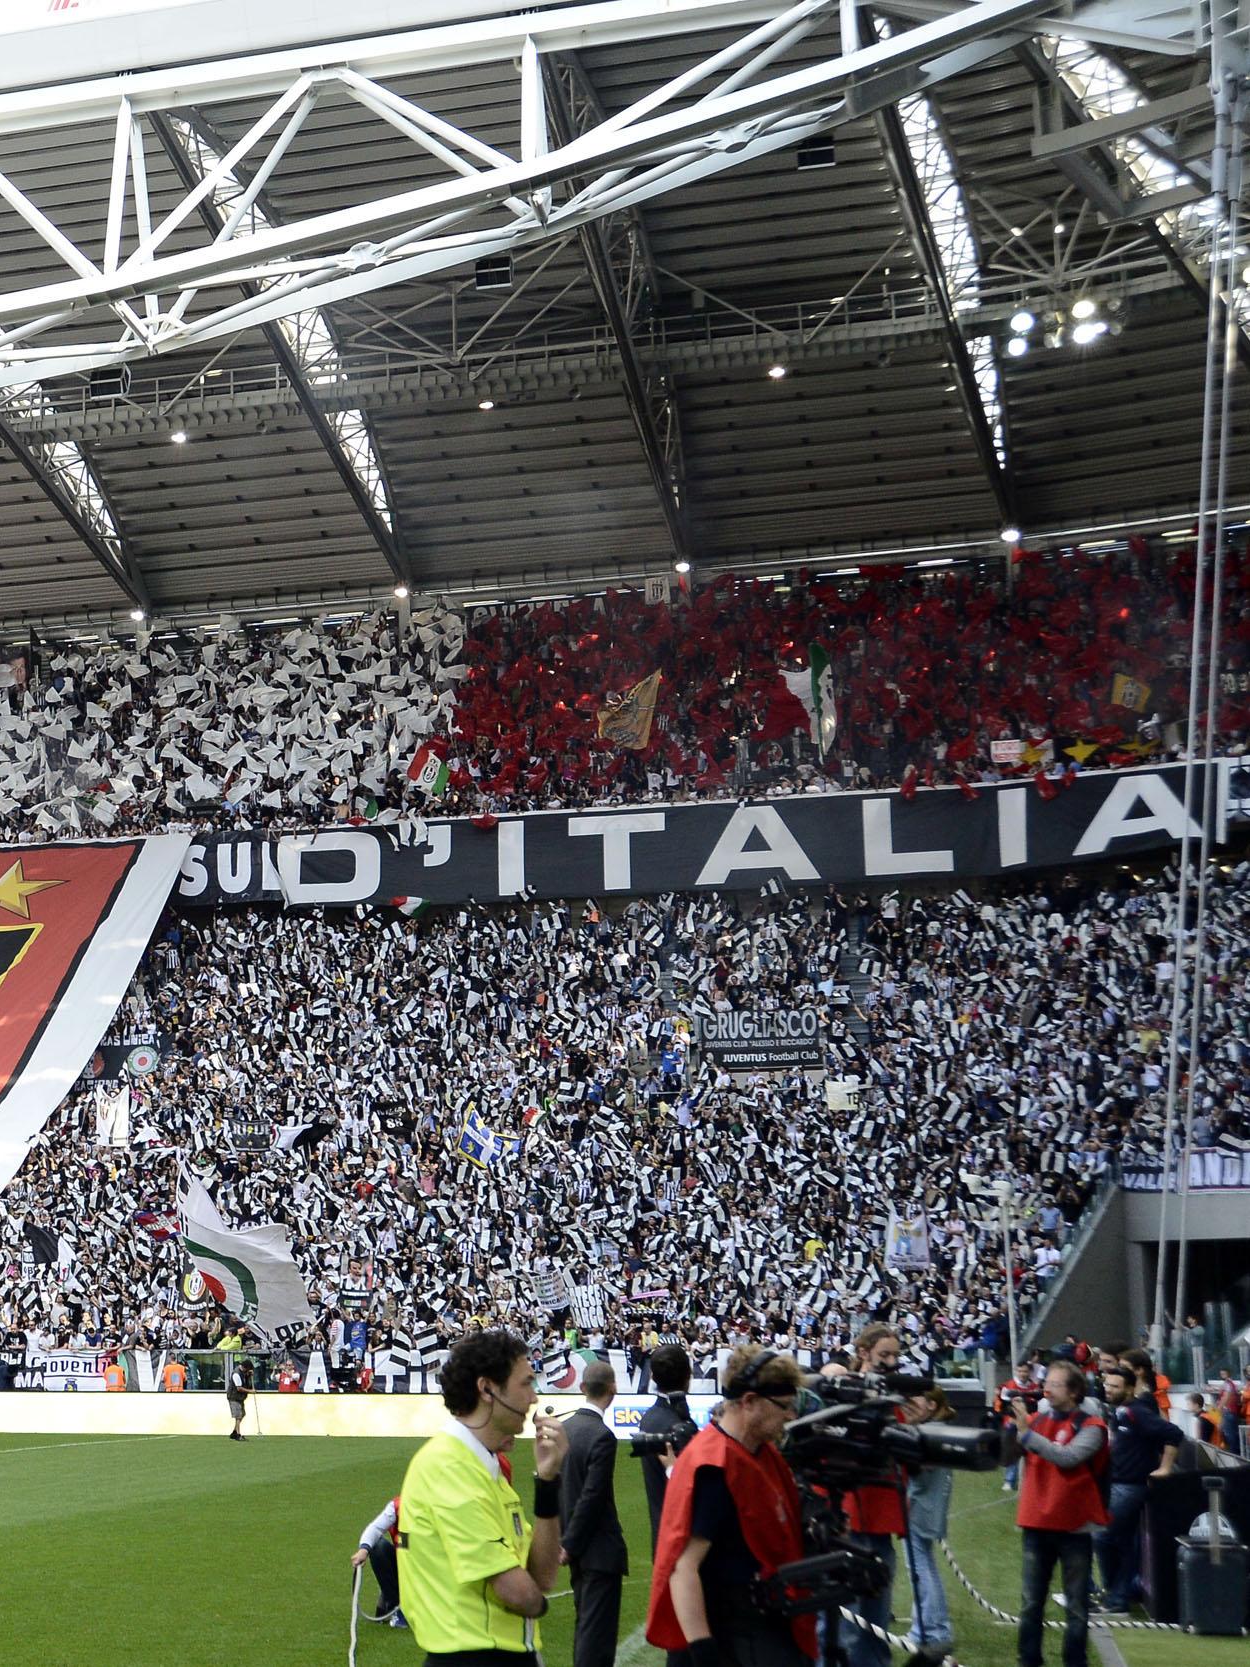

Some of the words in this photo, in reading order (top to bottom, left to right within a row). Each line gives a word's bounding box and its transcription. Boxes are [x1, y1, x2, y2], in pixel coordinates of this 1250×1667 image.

[277, 774, 1204, 904] D'ITALIA
[723, 1053, 767, 1063] JUVENTUS
[769, 1052, 800, 1062] Football
[801, 1051, 819, 1061] Club
